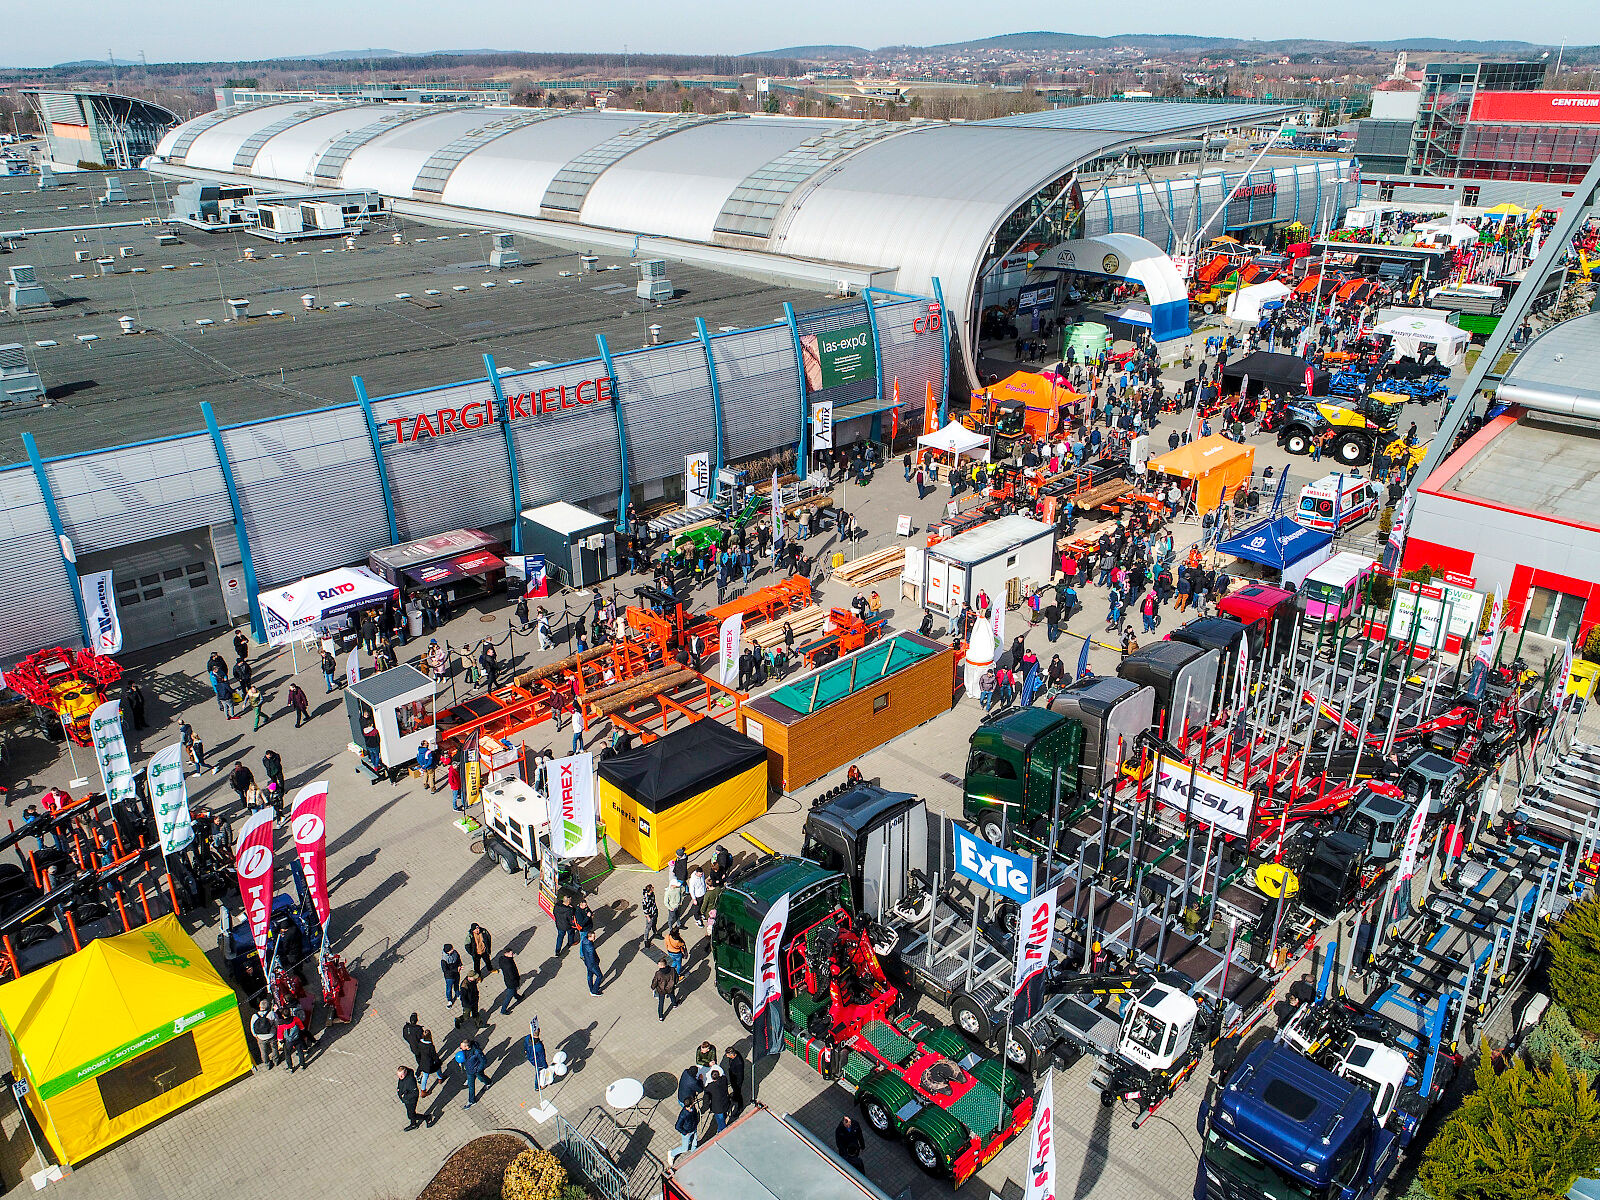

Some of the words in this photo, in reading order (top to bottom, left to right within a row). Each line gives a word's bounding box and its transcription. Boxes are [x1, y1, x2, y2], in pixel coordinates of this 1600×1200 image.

[1551, 98, 1599, 107] CENTRUM
[1232, 186, 1253, 199] ARGI
[913, 314, 941, 334] C/D
[387, 400, 494, 444] TARGI
[508, 376, 612, 421] KIELCE
[815, 407, 831, 443] Amix
[690, 459, 708, 499] Amix
[317, 583, 355, 600] RATO
[292, 615, 315, 627] RATO
[469, 766, 478, 797] Eneria
[560, 762, 574, 820] WIREX
[612, 801, 636, 824] Eneria
[1172, 775, 1245, 822] KESLA
[959, 833, 1029, 895] ExTe
[77, 1057, 112, 1077] AGROMET
[115, 1032, 160, 1058] MOTOIMPORT
